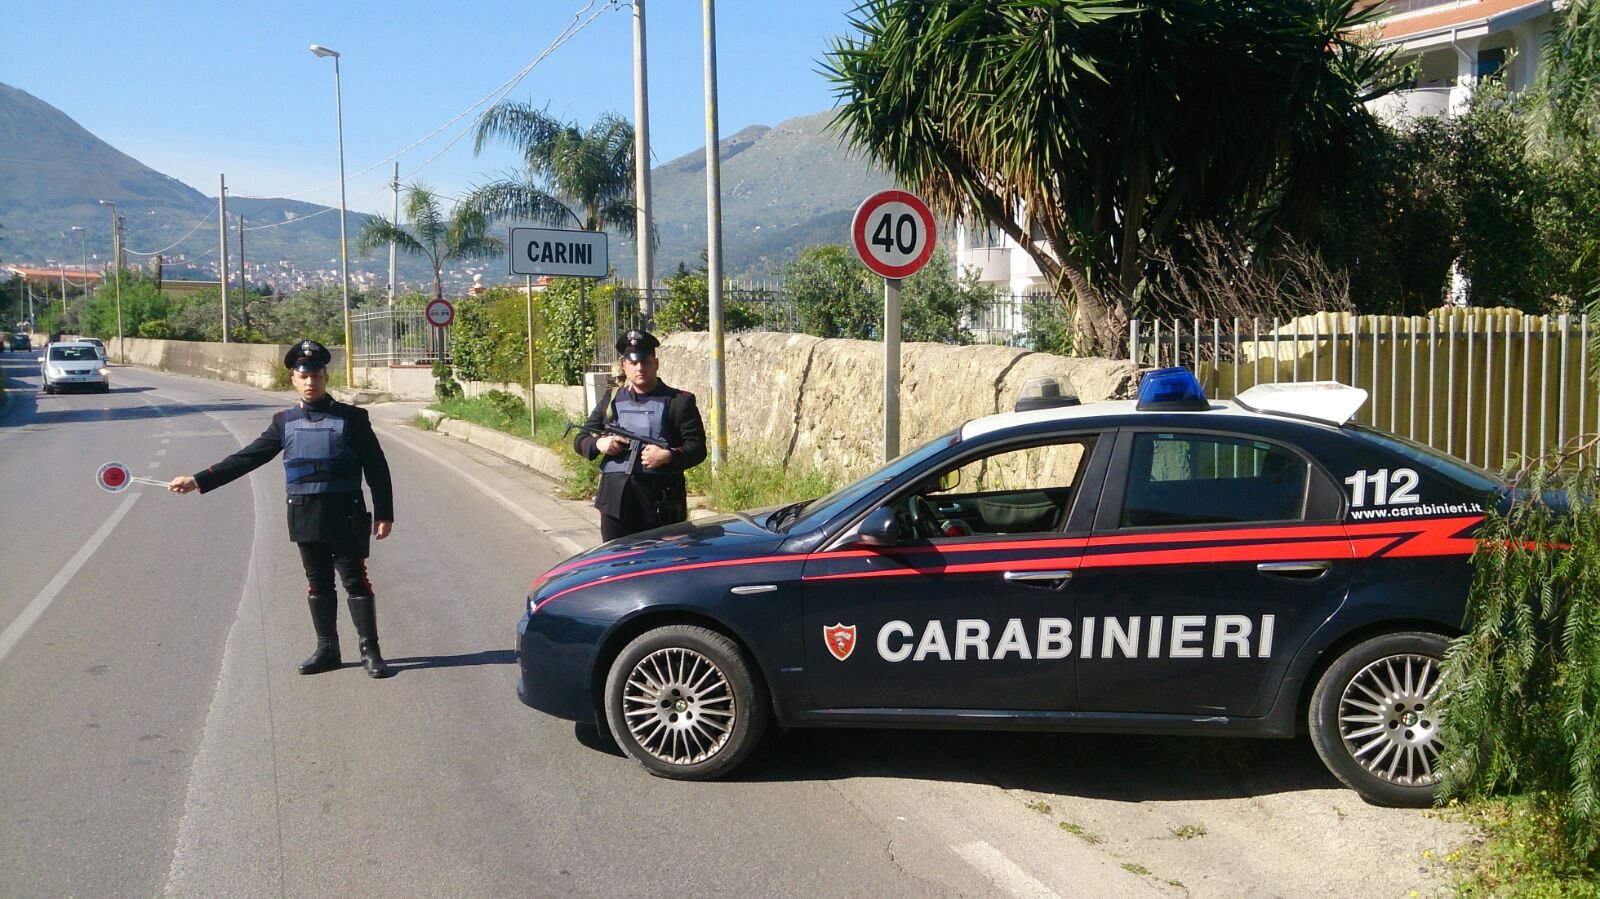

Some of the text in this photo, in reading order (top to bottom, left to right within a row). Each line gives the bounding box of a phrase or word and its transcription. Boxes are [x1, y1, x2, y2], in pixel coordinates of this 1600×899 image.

[527, 241, 592, 265] CARINI
[872, 213, 917, 255] 40
[1345, 468, 1420, 507] 112
[1351, 503, 1482, 520] www.carabinieri.it
[877, 614, 1275, 663] CARABINIERI
